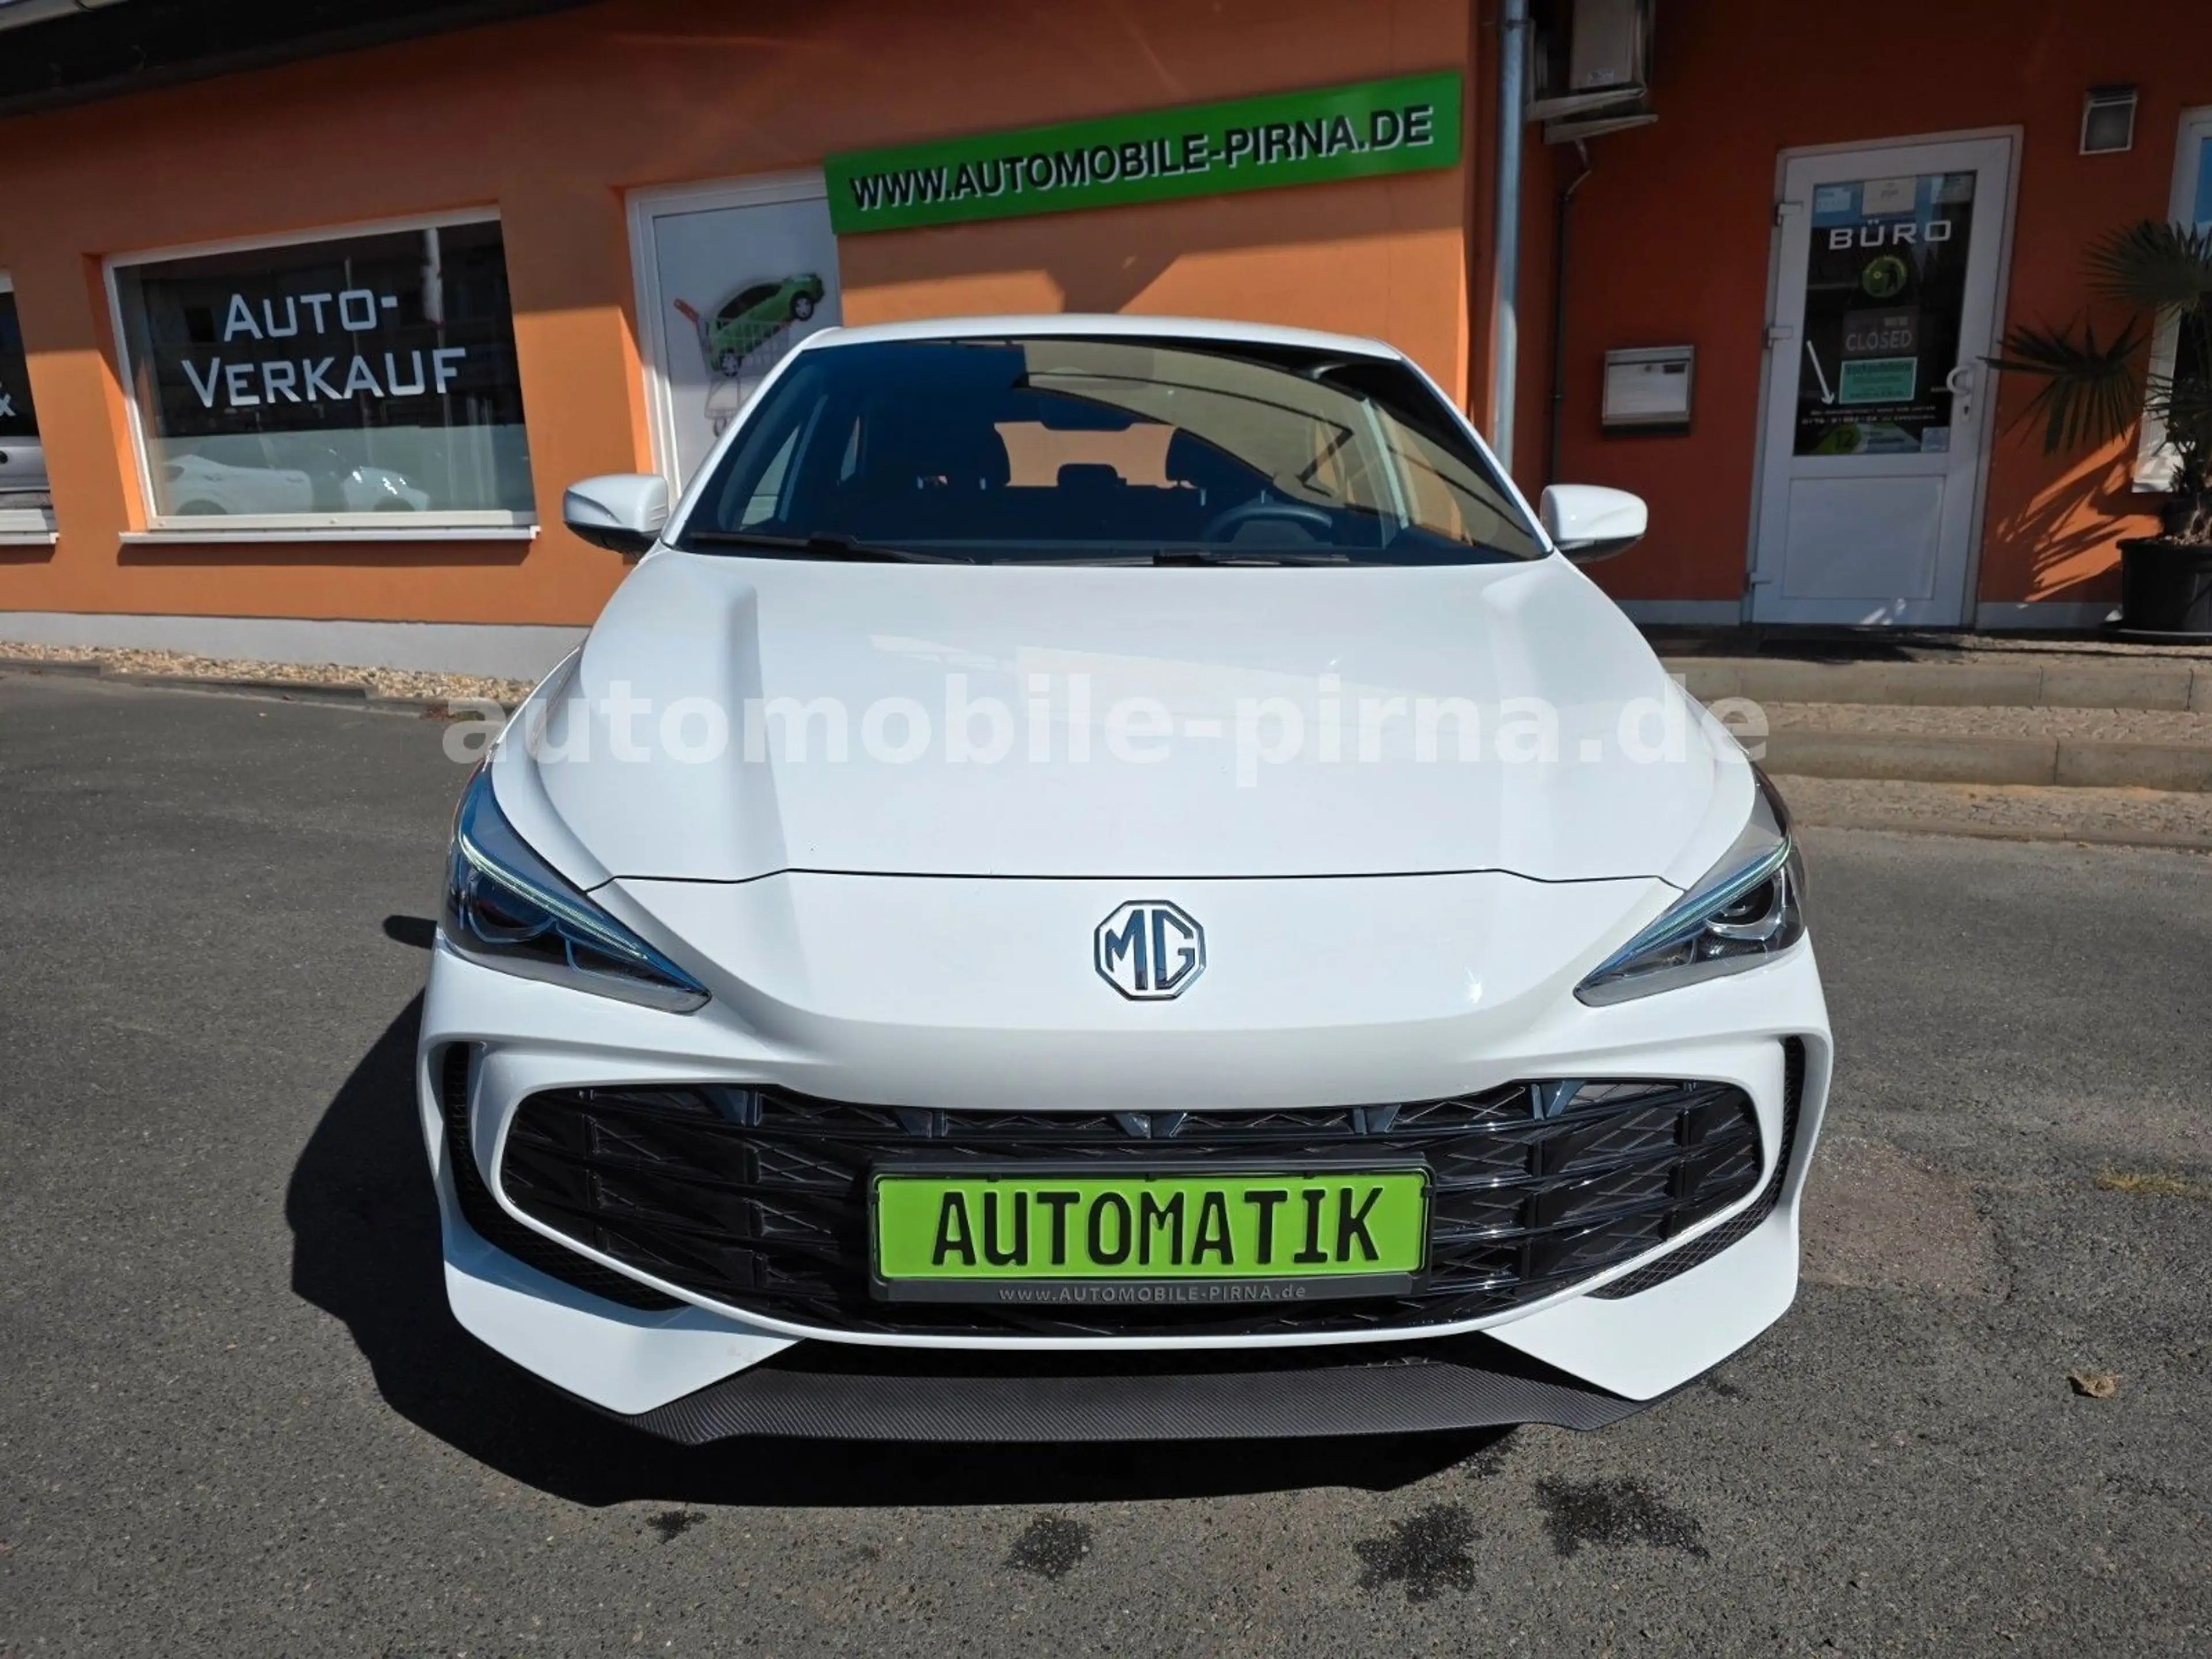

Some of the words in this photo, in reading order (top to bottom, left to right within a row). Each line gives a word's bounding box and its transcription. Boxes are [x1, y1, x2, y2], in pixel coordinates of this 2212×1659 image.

[849, 104, 1434, 211] WWW.AUTOMOBILE-PIRNA.DE
[1829, 219, 1952, 250] BÜRO
[224, 289, 399, 342] AUTO-
[1846, 329, 1913, 351] CLOSED
[181, 348, 466, 408] VERKAUF
[1104, 909, 1196, 991] MG
[931, 1186, 1385, 1267] AUTOMATIK
[998, 1283, 1306, 1303] www.AUTOMOBILE-PIRNA.de
